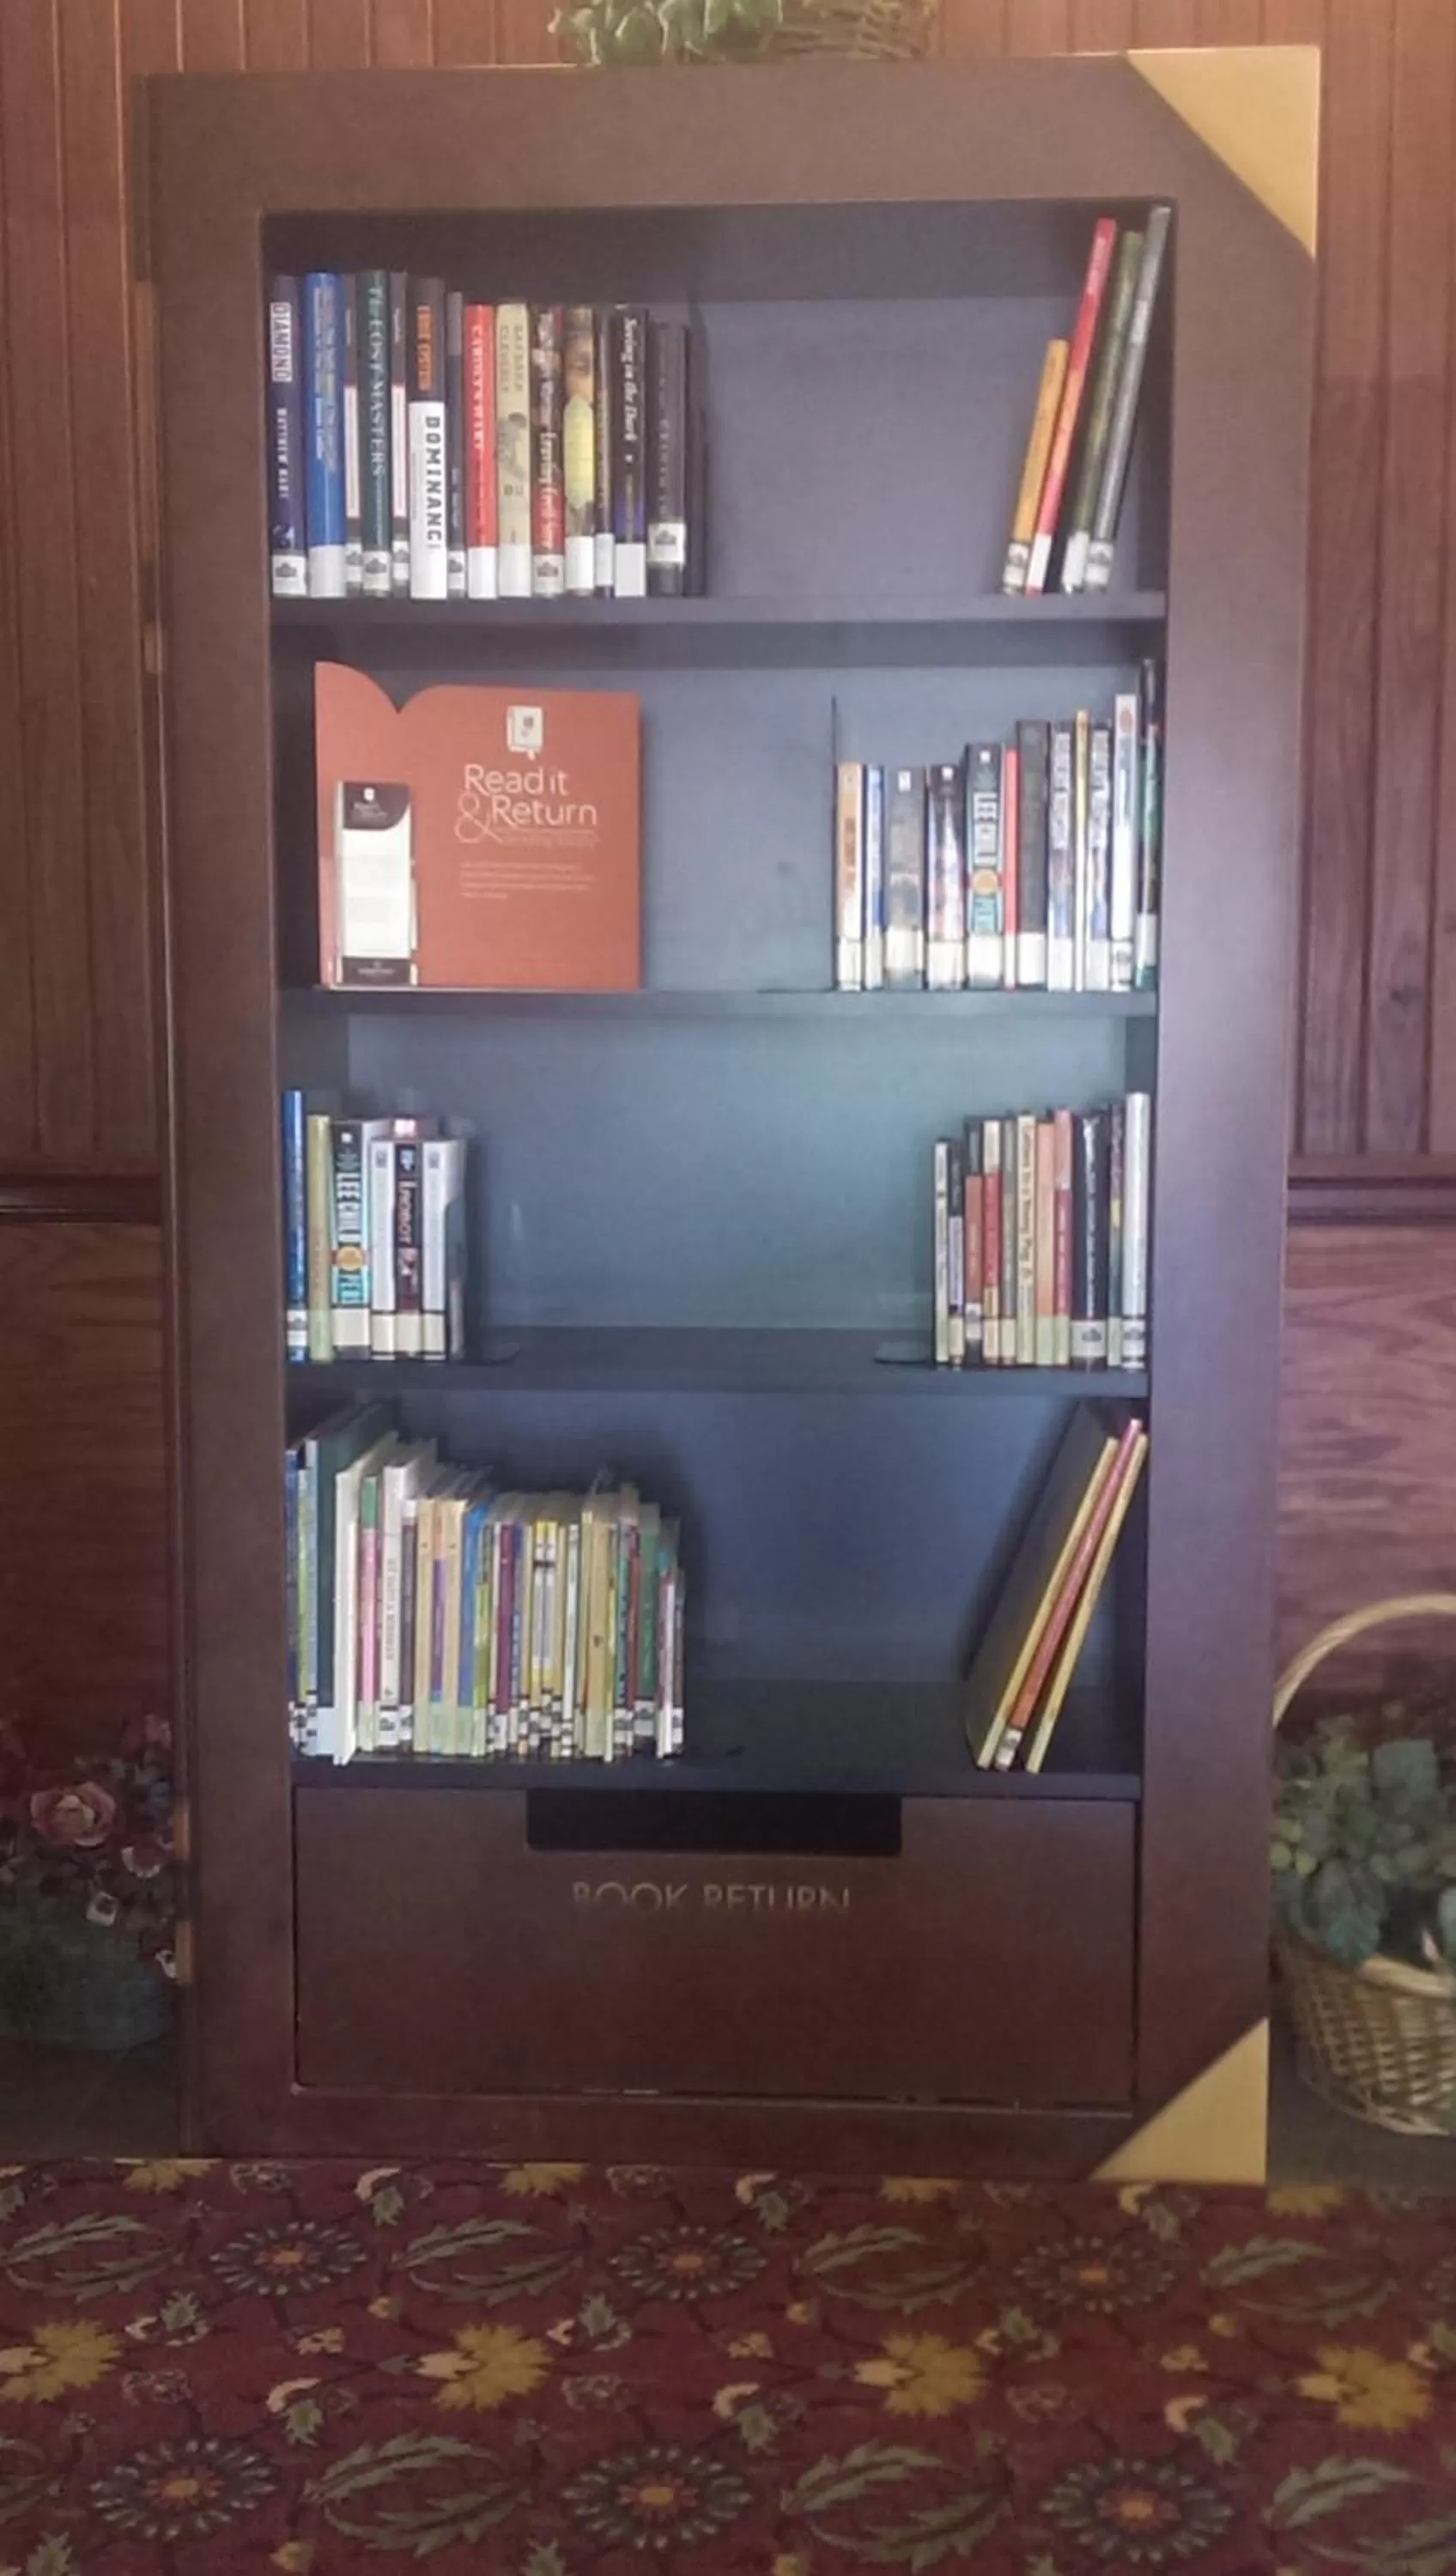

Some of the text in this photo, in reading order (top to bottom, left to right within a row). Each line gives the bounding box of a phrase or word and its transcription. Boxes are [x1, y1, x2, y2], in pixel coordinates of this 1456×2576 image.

[271, 303, 293, 382] DIAMOND
[369, 380, 385, 477] MASTERS
[464, 762, 570, 797] Read it
[454, 790, 505, 844] &
[491, 793, 598, 829] Return
[337, 1172, 361, 1199] LEE
[572, 1880, 688, 1911] BOOK
